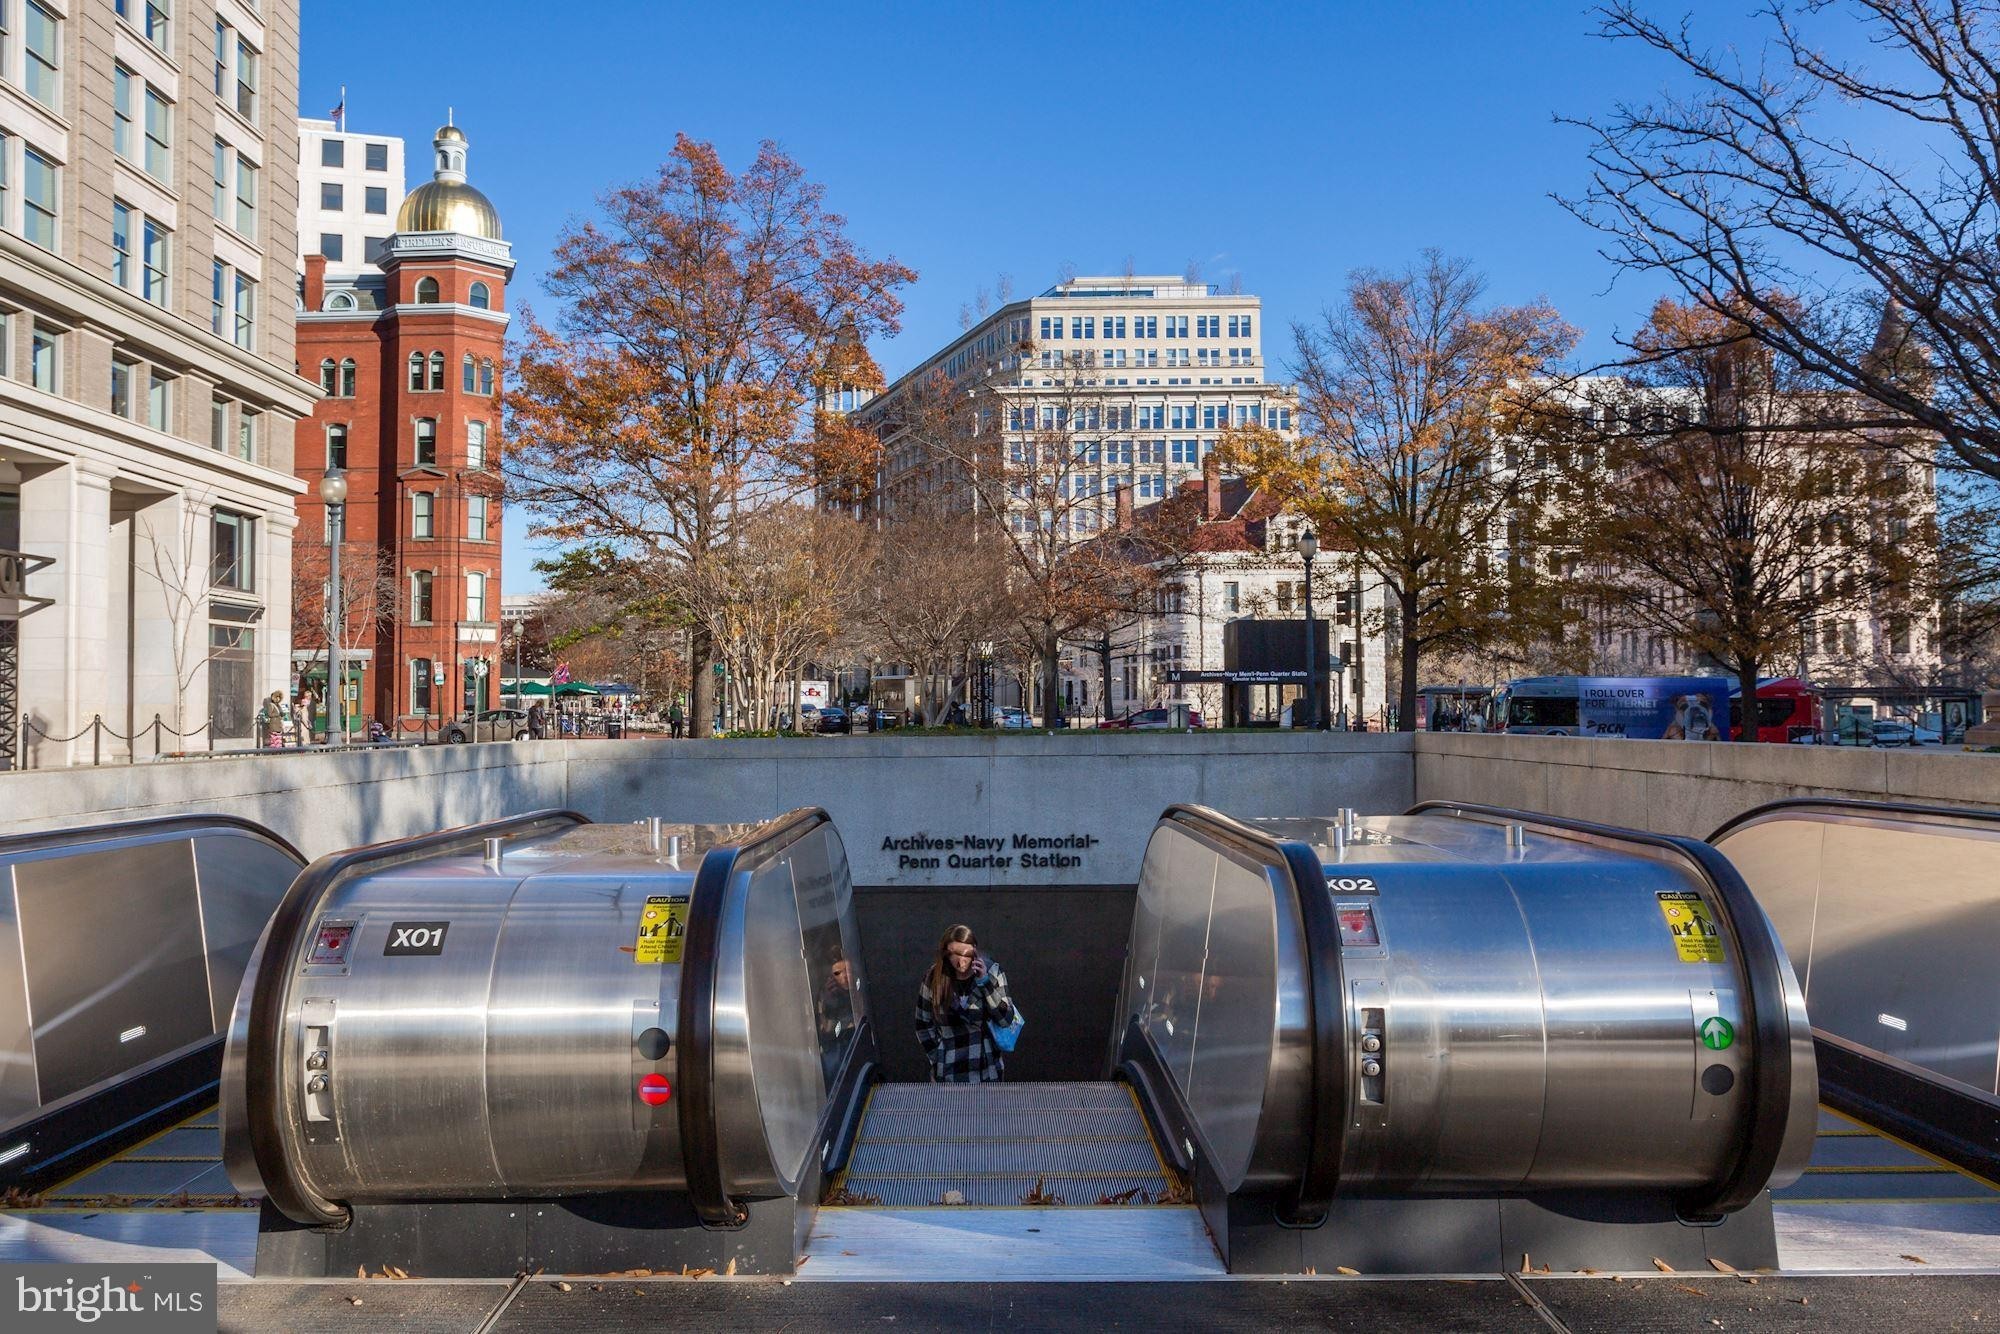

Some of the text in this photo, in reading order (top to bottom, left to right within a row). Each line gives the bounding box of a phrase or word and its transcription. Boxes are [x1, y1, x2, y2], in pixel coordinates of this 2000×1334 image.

[1171, 672, 1180, 681] M
[1590, 689, 1615, 698] ROLL
[1617, 689, 1644, 698] OVER
[1585, 699, 1658, 708] FOR INTERNET
[1597, 723, 1626, 733] RCN
[881, 833, 1099, 851] Archives-Navy Memorial-
[899, 853, 1082, 869] Penn Quarter Station
